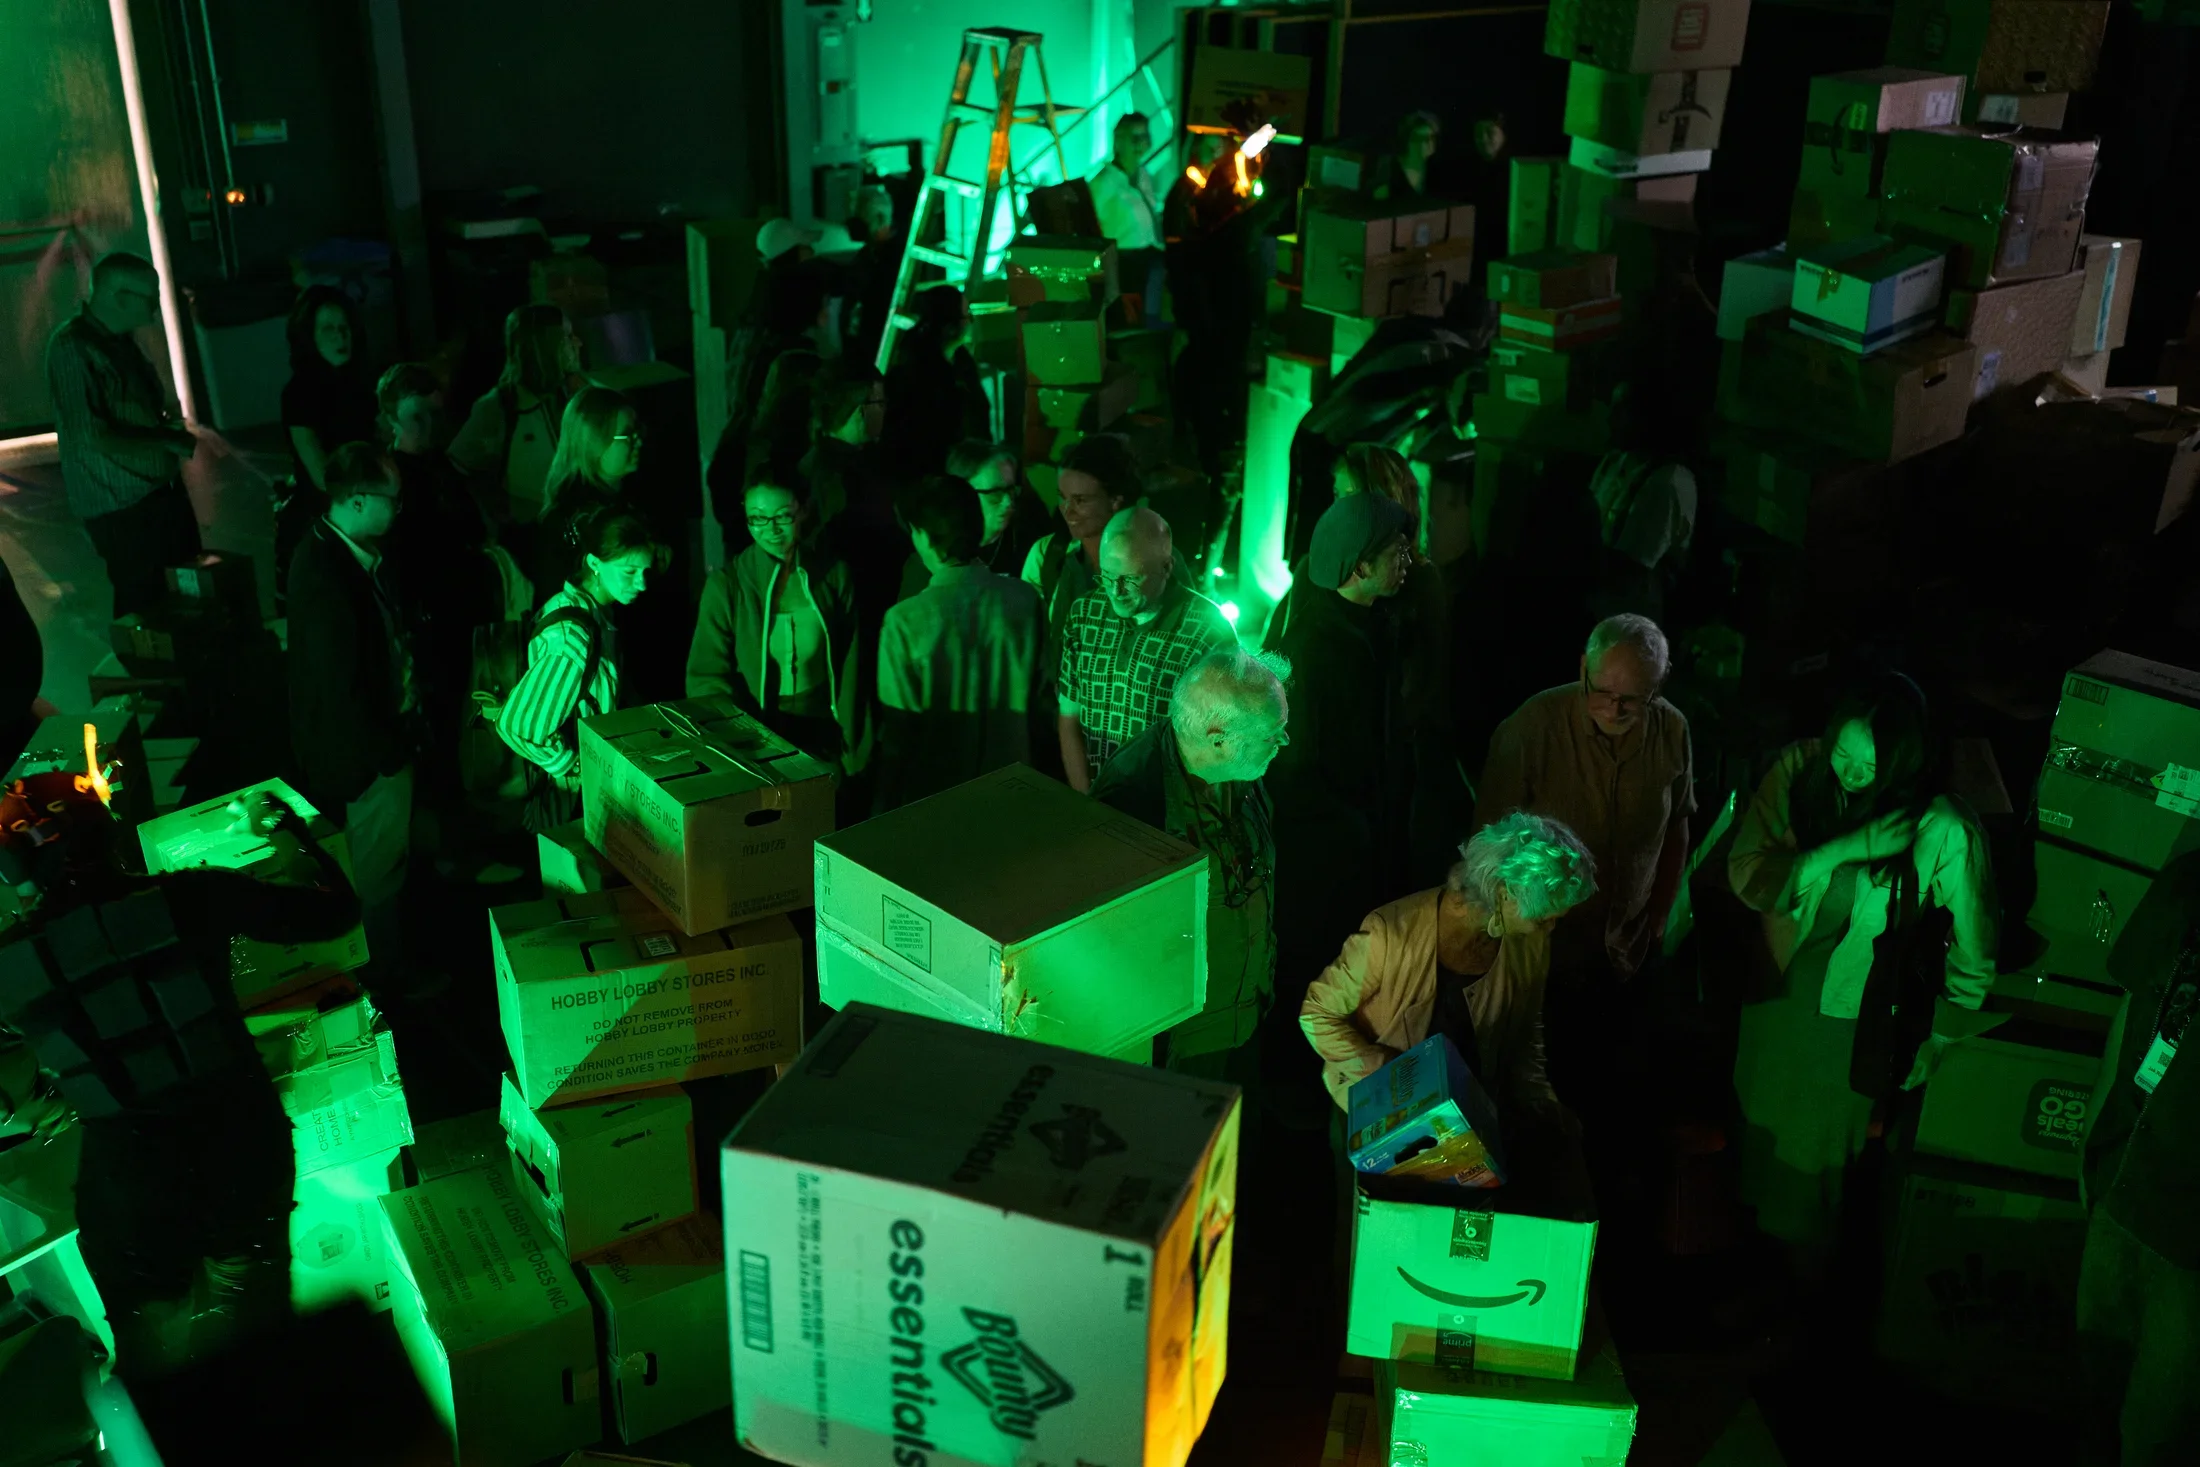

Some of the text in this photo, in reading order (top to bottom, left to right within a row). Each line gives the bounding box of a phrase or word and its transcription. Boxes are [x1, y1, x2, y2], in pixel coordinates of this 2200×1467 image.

[629, 783, 661, 822] STORES
[551, 962, 769, 1011] HOBBY LOBBY STORES INC.
[585, 1008, 742, 1045] HOBBY LOBBY PROPERTY
[592, 998, 734, 1031] DO NOT REMOVE FROM
[546, 1069, 613, 1091] CONDITION
[616, 1062, 656, 1080] SAVES
[657, 1056, 682, 1072] THE
[683, 1045, 741, 1067] COMPANY
[553, 1054, 626, 1077] RETURNING
[627, 1050, 655, 1063] THIS
[656, 1036, 724, 1059] CONTAINER
[725, 1033, 739, 1046] IN
[311, 1107, 329, 1152] CREAT
[326, 1107, 343, 1147] HOME
[1361, 1156, 1377, 1171] 12
[482, 1162, 569, 1314] HOBBY LOBBY STORES INC.
[1103, 1244, 1146, 1268] 1
[888, 1218, 934, 1467] essentials
[1441, 1336, 1473, 1350] prime
[960, 1305, 1038, 1442] Bounty
